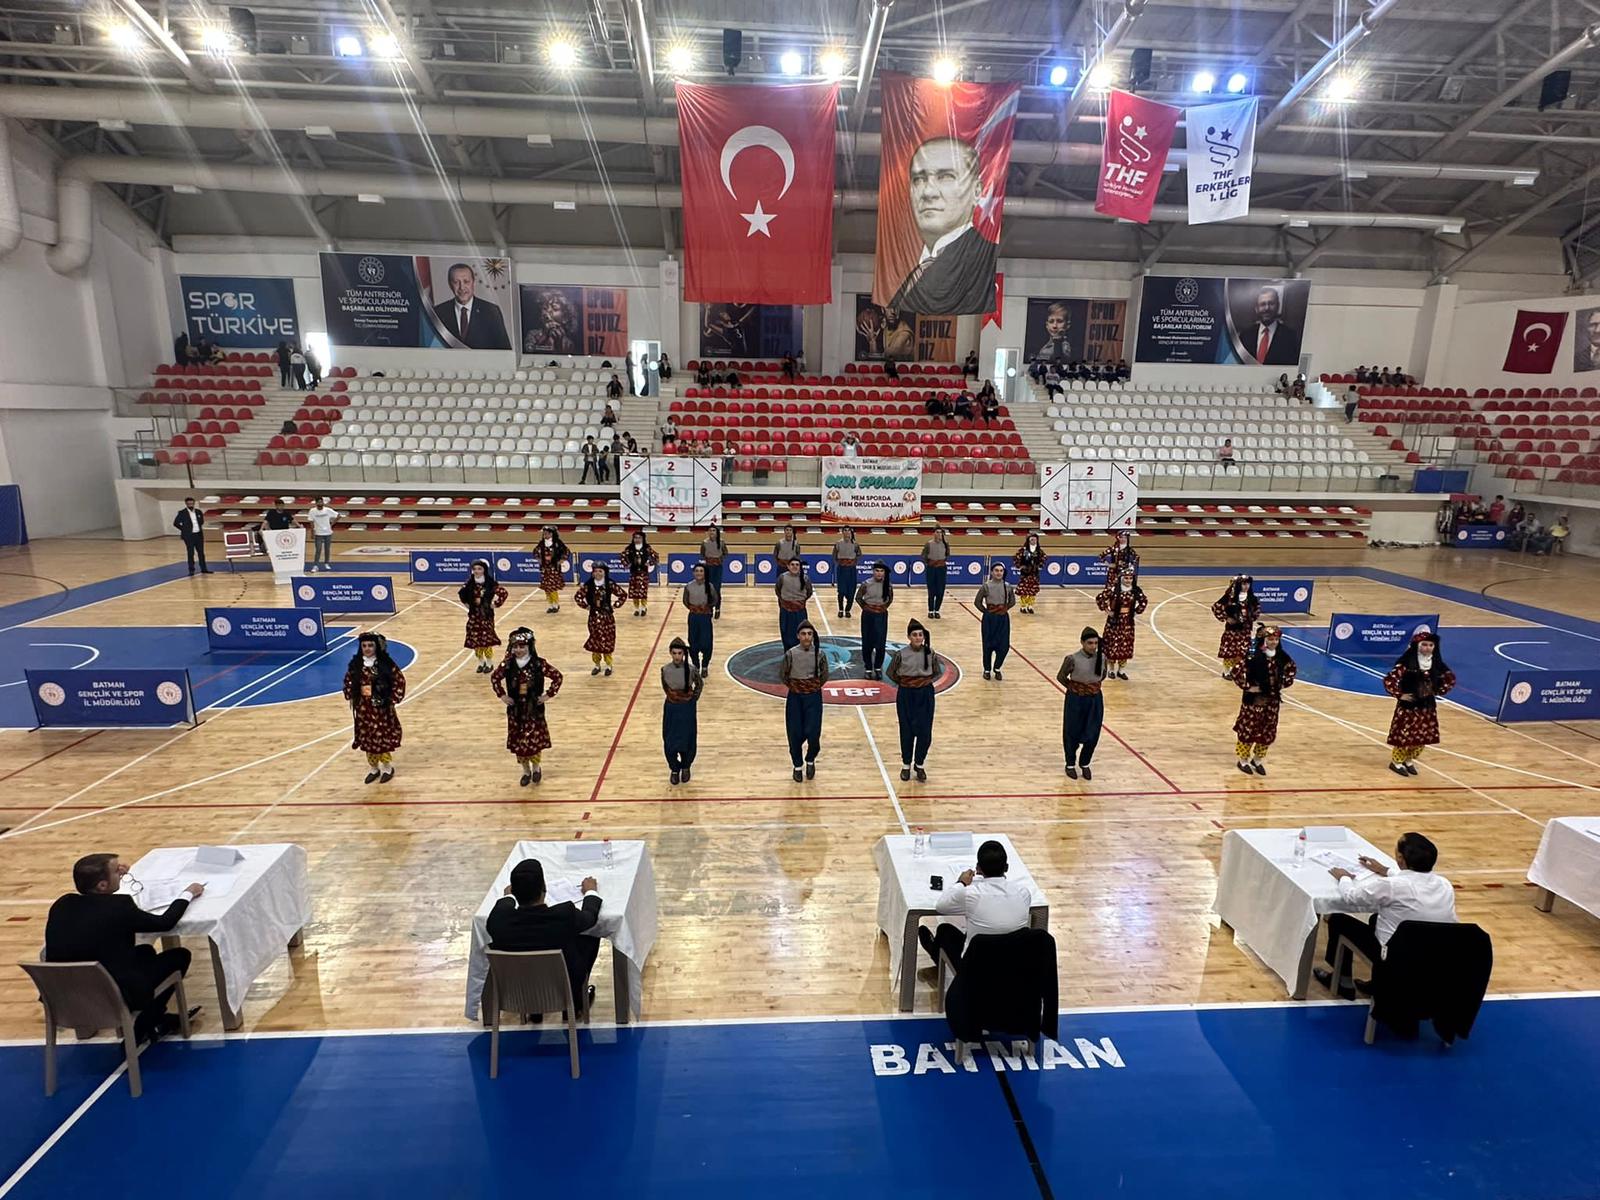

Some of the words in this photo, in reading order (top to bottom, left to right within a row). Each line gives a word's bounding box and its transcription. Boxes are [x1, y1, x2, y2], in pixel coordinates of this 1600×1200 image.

[1106, 162, 1148, 187] THF
[1212, 169, 1234, 181] THF
[1195, 176, 1251, 193] ERKEKLER
[1209, 193, 1217, 202] 1.
[345, 289, 363, 298] TÜM
[363, 289, 402, 299] ANTRENÖR
[188, 291, 256, 311] SPOR
[1160, 308, 1174, 317] TÜM
[1174, 308, 1209, 317] ANTRENÖR
[1152, 315, 1160, 323] VE
[191, 313, 295, 336] TÜRKİYE
[624, 460, 631, 470] 5
[667, 461, 675, 471] 2
[711, 462, 718, 472] 5
[1045, 466, 1052, 476] 5
[1086, 466, 1094, 476] 2
[1127, 466, 1135, 476] 5
[825, 472, 857, 489] OKUL
[858, 475, 919, 490] SPORLARI
[632, 486, 640, 496] 3
[668, 487, 675, 497] 1
[700, 487, 708, 498] 3
[1052, 491, 1060, 501] 3
[1086, 491, 1093, 501] 1
[1116, 491, 1124, 501] 3
[624, 512, 632, 522] 4
[668, 512, 676, 522] 2
[1043, 517, 1051, 527] 4
[1085, 515, 1093, 525] 2
[1124, 517, 1132, 526] 4
[78, 690, 111, 699] GENÇLİK
[112, 690, 122, 698] VE
[123, 690, 145, 698] SPOR
[823, 687, 881, 697] TBF
[1540, 689, 1566, 697] GENÇLİK
[83, 698, 92, 707] İL
[92, 698, 141, 707] MÜDÜRLÜĞÜ
[870, 1037, 1126, 1077] BATMAN
